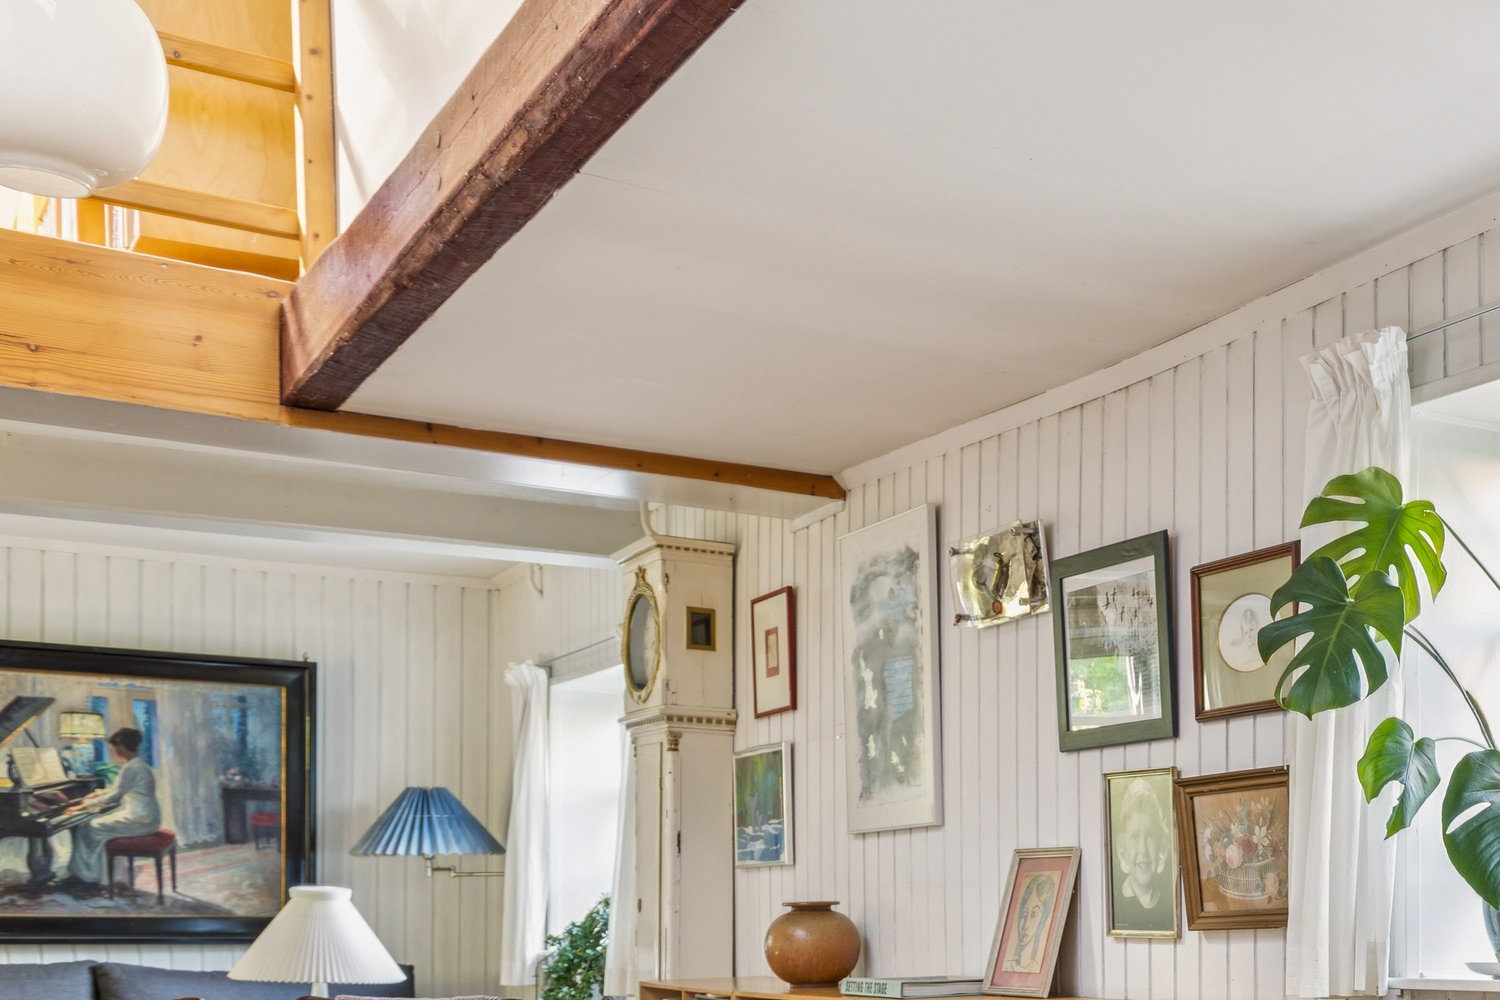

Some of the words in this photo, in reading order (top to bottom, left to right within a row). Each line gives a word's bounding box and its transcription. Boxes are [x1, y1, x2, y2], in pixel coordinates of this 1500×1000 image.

[845, 980, 864, 993] SETTING
[864, 982, 873, 993] THE
[874, 982, 888, 994] STAGE
